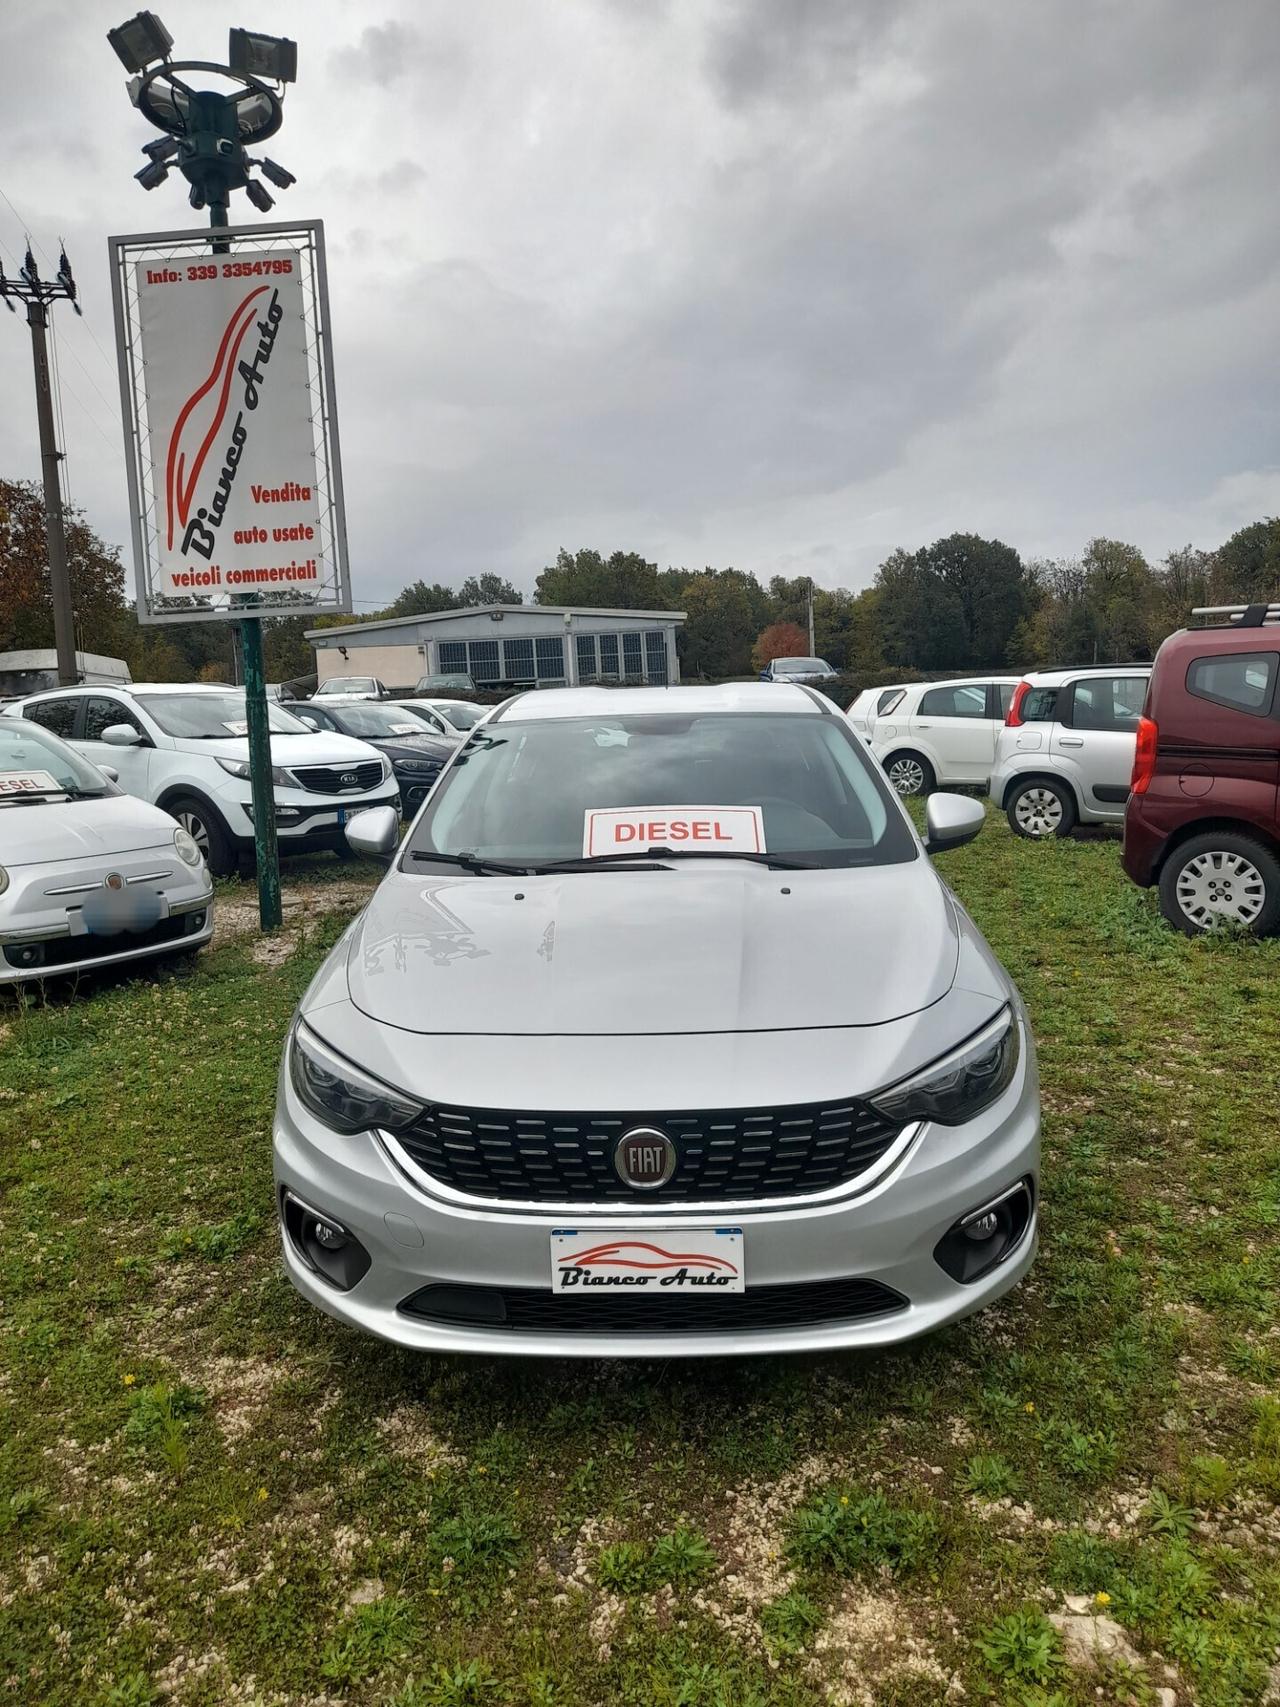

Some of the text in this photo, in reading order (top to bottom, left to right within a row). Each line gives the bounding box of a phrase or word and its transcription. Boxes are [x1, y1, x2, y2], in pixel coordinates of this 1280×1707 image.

[146, 259, 293, 284] Info: 339 3354795
[181, 287, 284, 561] Bianco Auto
[250, 481, 311, 504] Vendita
[233, 522, 314, 545] auto usate
[171, 560, 317, 587] veicoli commerciali
[614, 821, 733, 843] DIESEL
[629, 1147, 663, 1174] FIAT
[558, 1267, 738, 1287] Bianco Auto
